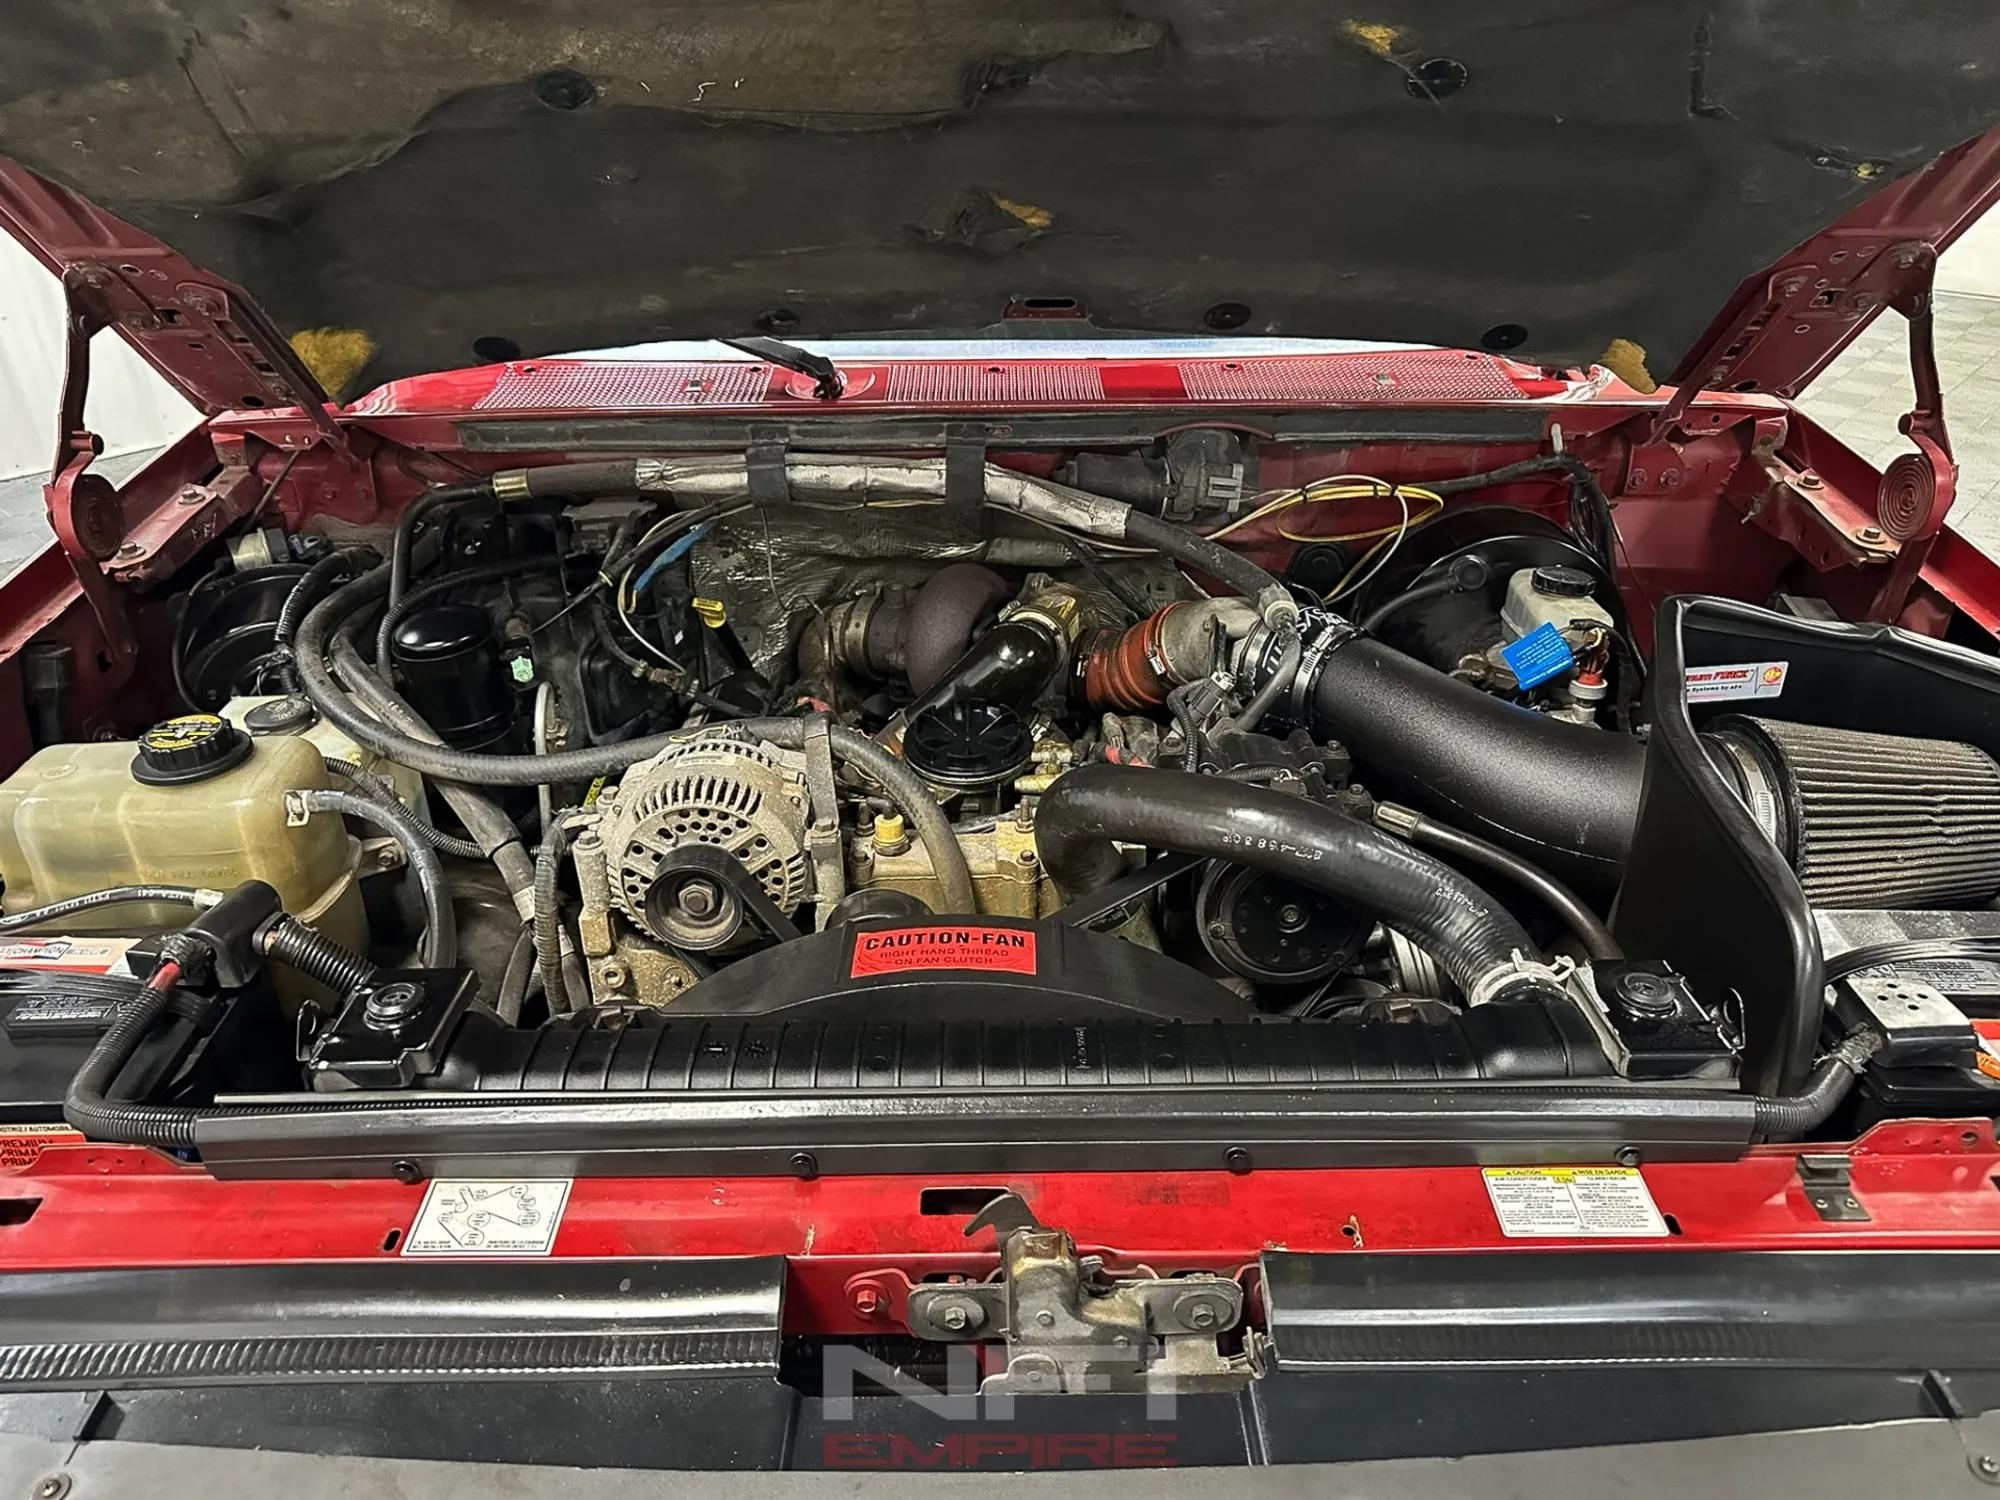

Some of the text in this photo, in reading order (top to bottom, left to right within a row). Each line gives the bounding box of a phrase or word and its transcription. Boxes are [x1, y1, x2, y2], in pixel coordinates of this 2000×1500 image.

[865, 931, 1025, 950] CAUTION-FAN
[13, 946, 62, 955] CHAMPION
[880, 950, 916, 959] RIGHT
[960, 948, 1009, 956] THREAD
[944, 956, 992, 964] CLUTCH
[2, 1158, 36, 1166] PRIM
